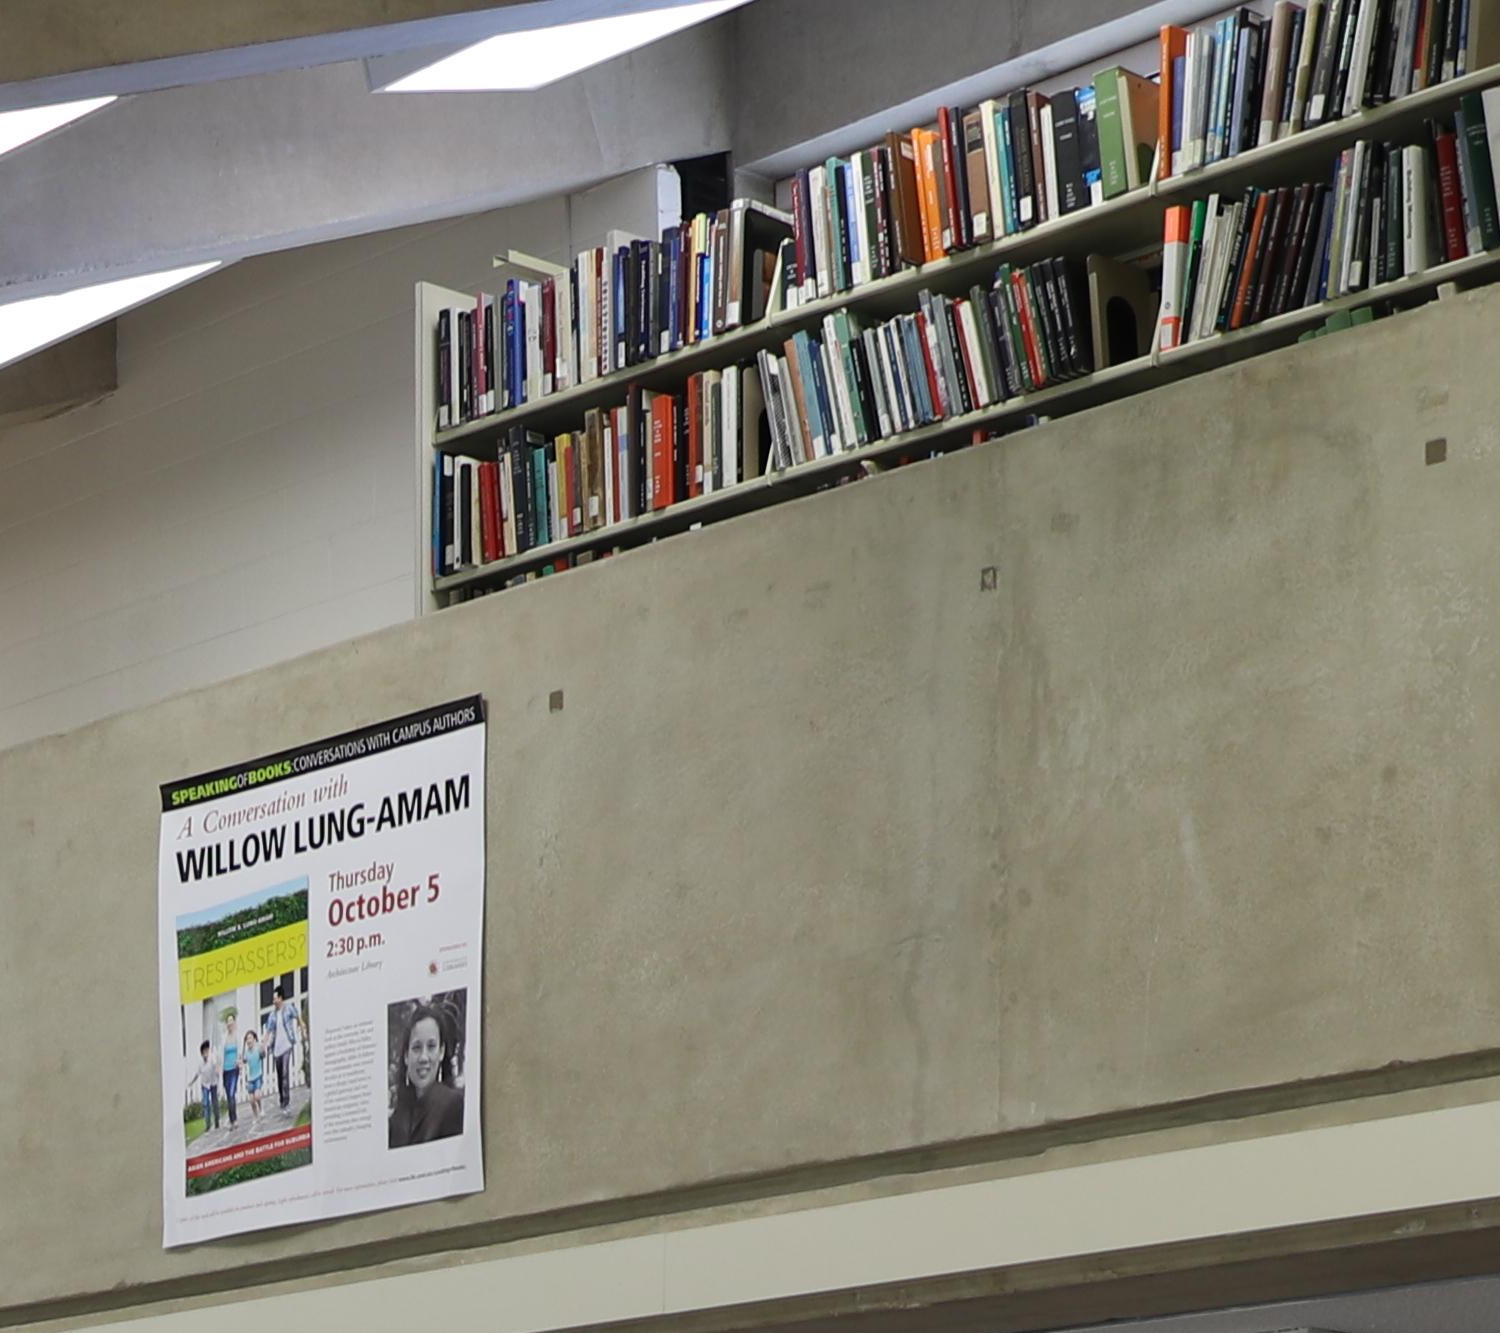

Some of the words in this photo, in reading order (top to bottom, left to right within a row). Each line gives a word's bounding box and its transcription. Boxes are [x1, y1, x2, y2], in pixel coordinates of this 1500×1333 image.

[366, 731, 390, 752] WITH
[392, 719, 431, 744] CAMPUS
[433, 706, 476, 733] AUTHORS
[176, 815, 194, 840] A
[203, 793, 305, 835] Conversation
[313, 774, 348, 805] with
[176, 818, 287, 883] WILLOW
[294, 774, 471, 855] LUNG-AMAM
[328, 860, 394, 893] Thursday
[328, 885, 420, 927] October
[427, 873, 440, 903] 5
[182, 932, 306, 993] TRESPASSERS?
[326, 935, 354, 958] 2:30
[356, 931, 386, 955] p.m.
